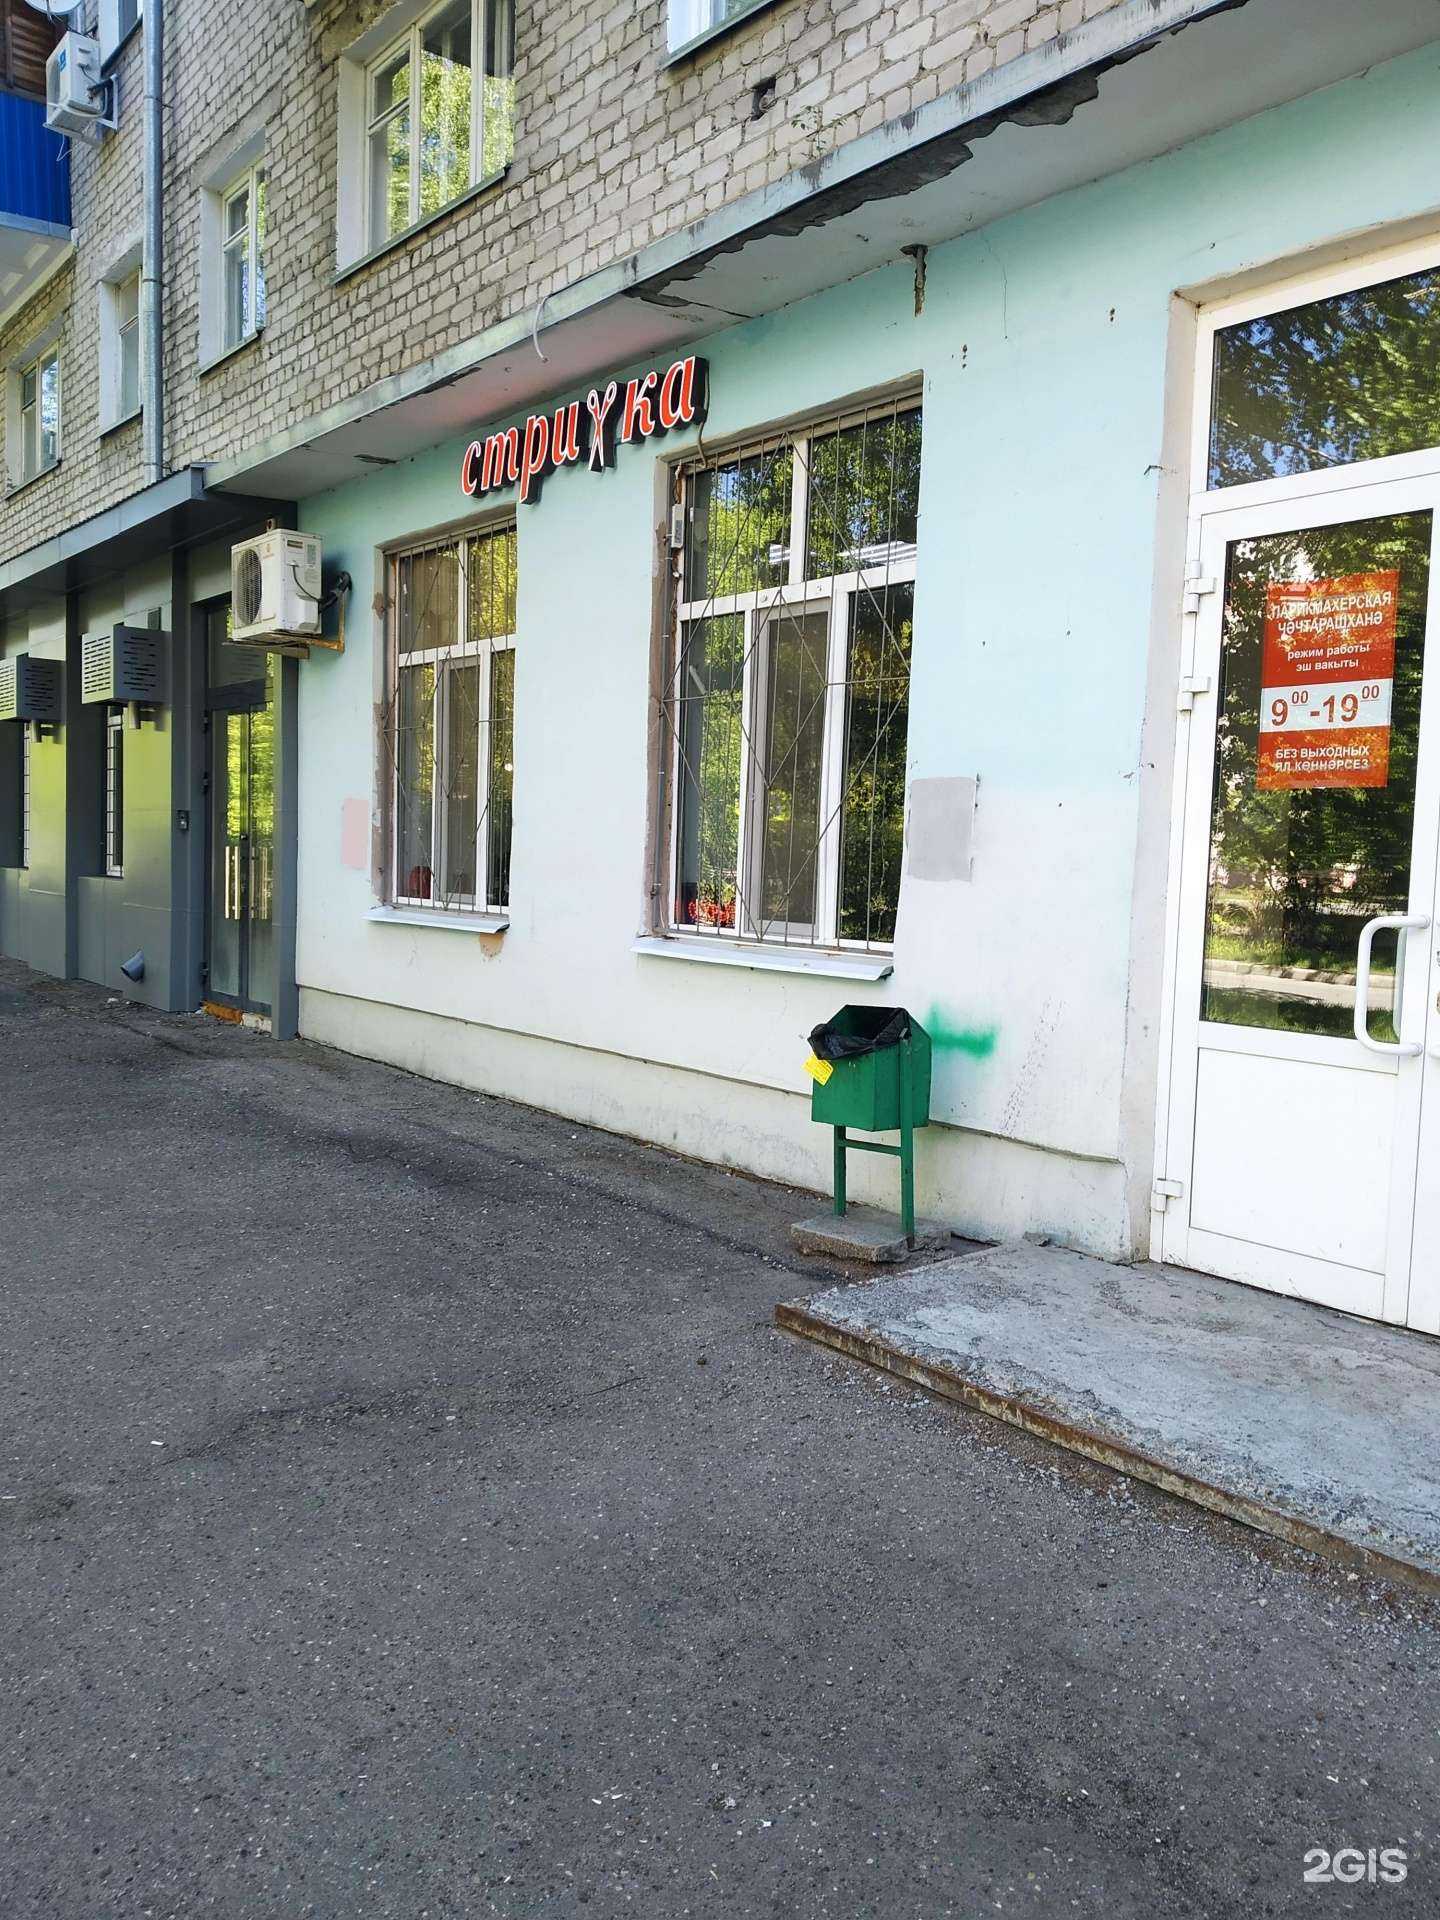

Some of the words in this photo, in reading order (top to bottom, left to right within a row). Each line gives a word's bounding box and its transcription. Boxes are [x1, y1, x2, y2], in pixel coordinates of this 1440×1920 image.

[1271, 591, 1392, 619] ПАРИКМАХЕРСКАЯ
[1287, 648, 1324, 661] режим
[1326, 643, 1370, 658] работы
[1296, 662, 1312, 672] эш
[1315, 658, 1359, 670] вакыты
[1276, 748, 1298, 759] БЕЗ
[1300, 745, 1370, 760] ВЫХОДНЫХ
